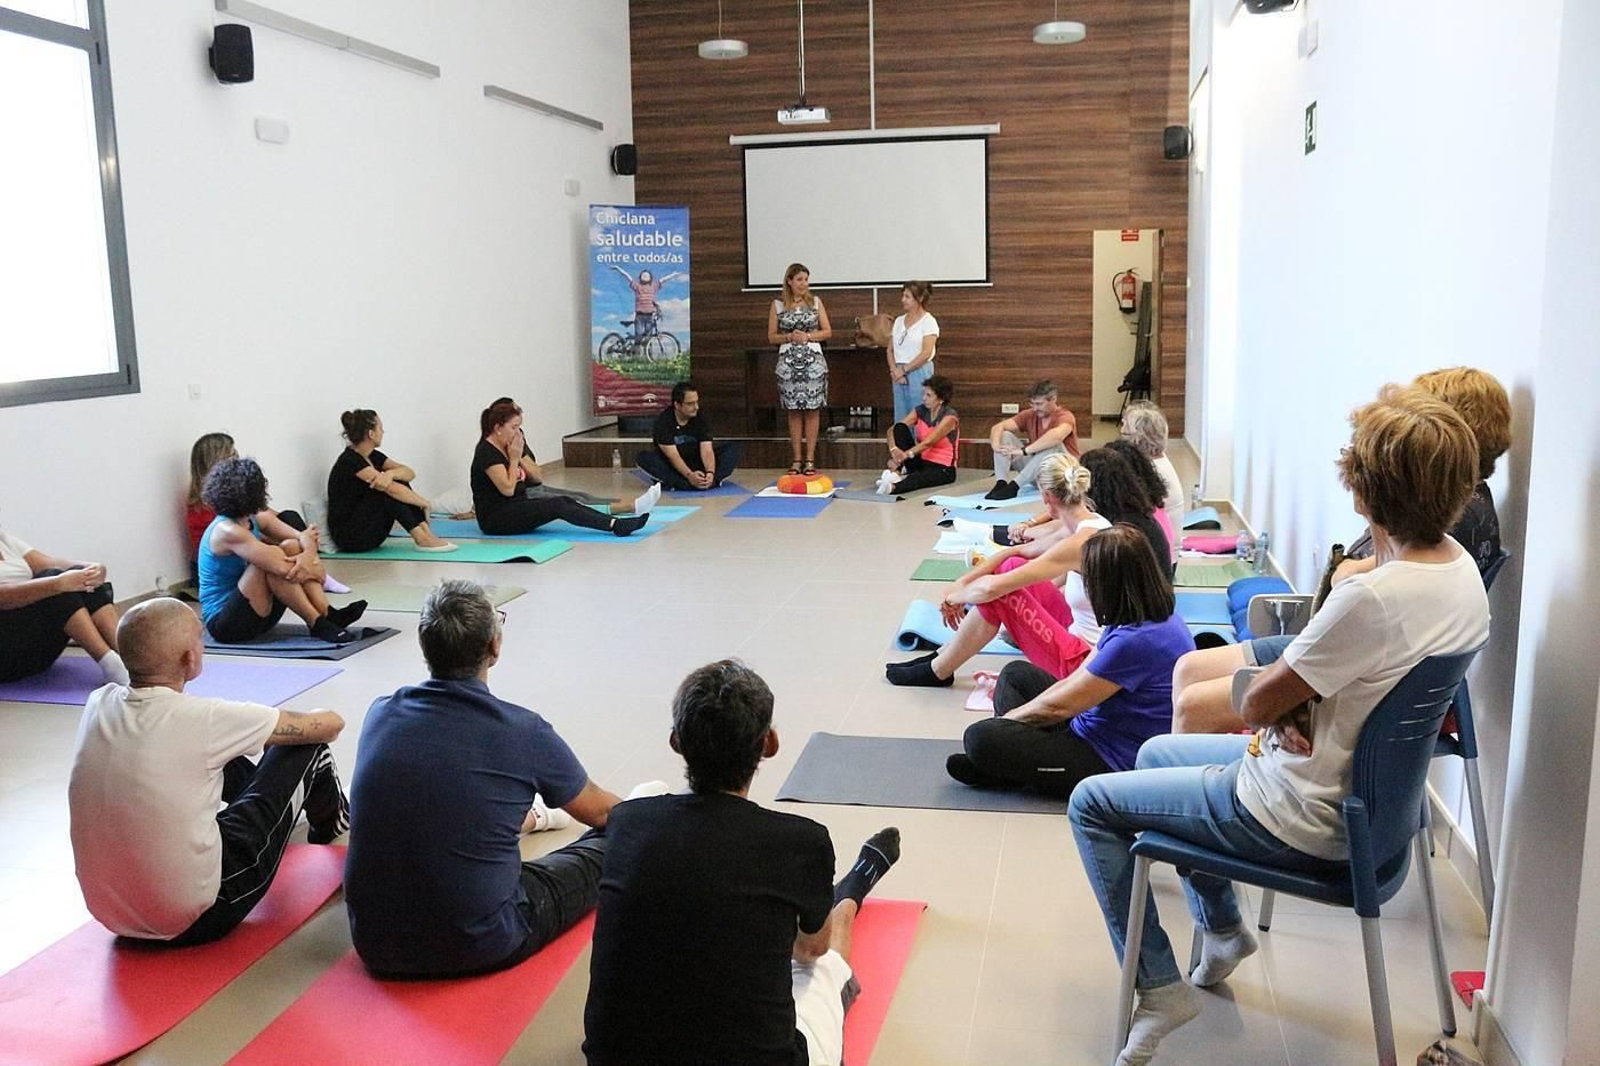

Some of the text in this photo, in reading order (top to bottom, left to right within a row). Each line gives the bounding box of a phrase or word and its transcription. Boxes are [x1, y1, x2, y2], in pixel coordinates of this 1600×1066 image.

[596, 211, 655, 225] Chiclana
[596, 230, 683, 247] saludable
[596, 251, 684, 263] entre todos/as
